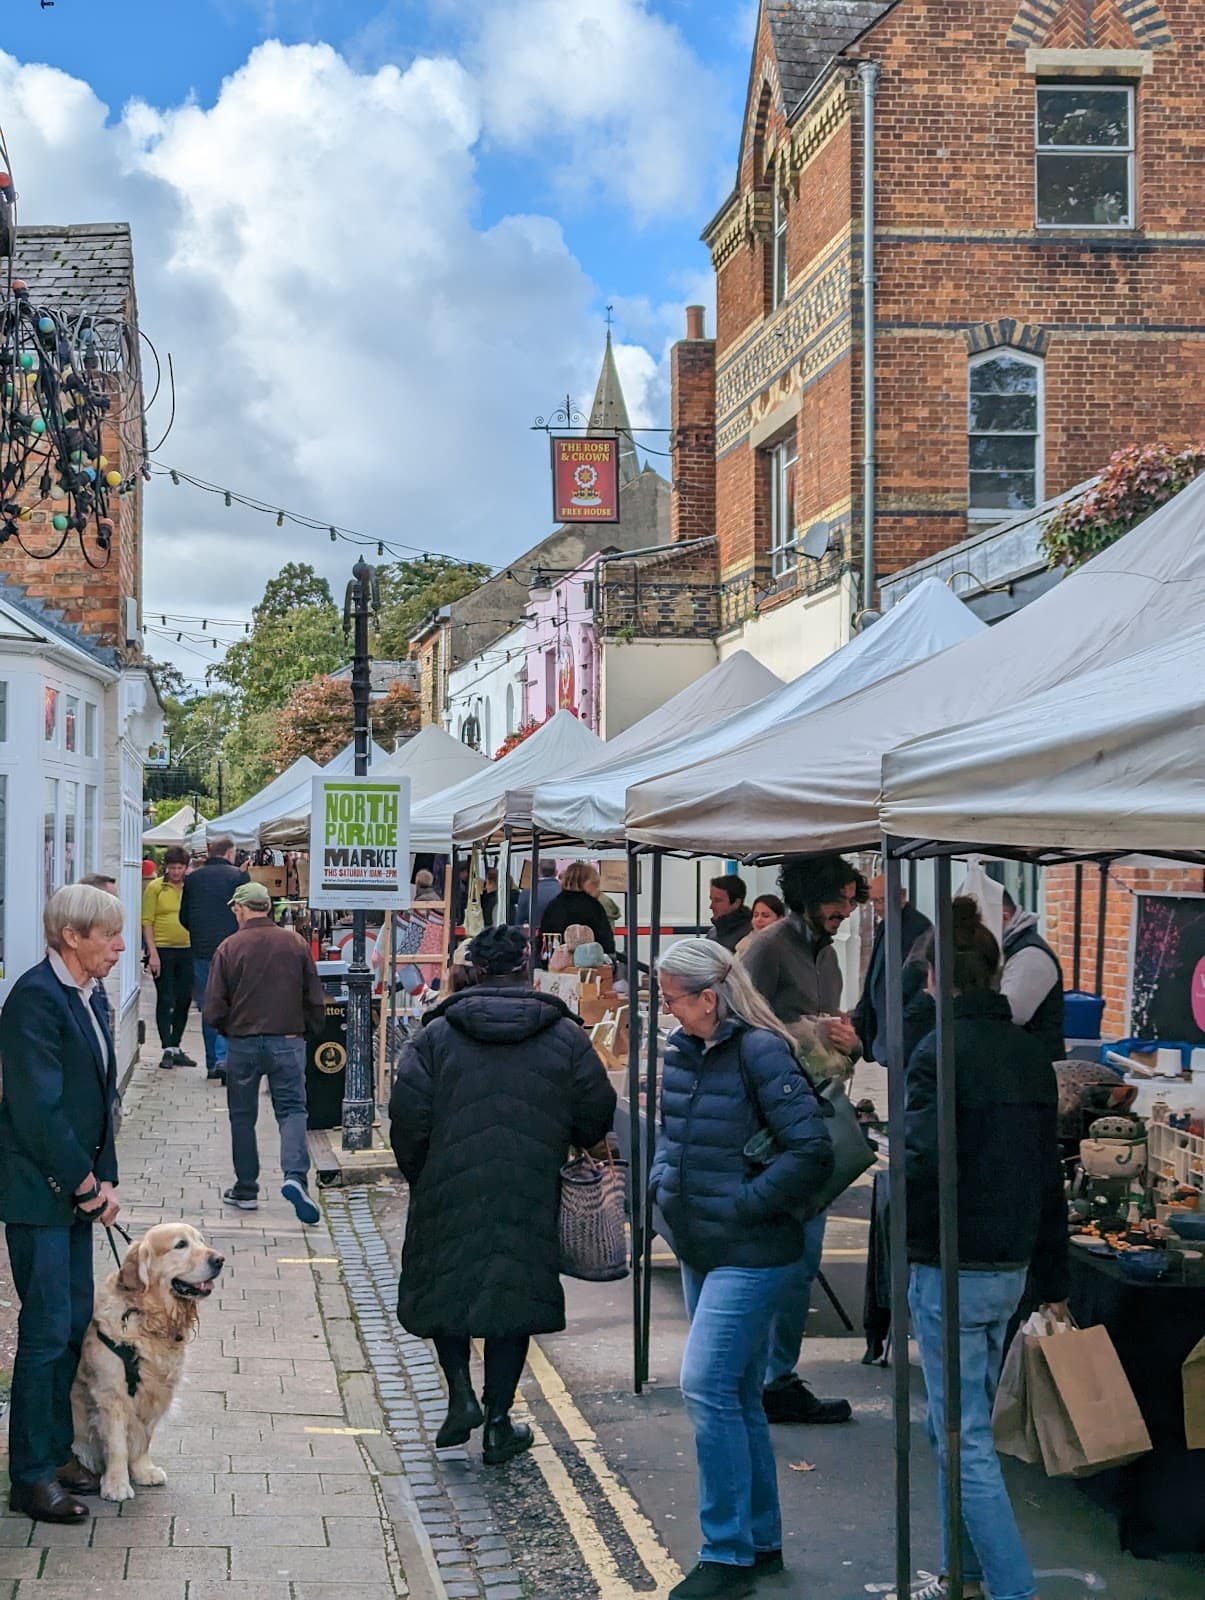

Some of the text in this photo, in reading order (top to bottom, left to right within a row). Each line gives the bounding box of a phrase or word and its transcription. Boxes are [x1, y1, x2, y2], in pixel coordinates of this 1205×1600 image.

[560, 443, 610, 452] THE ROSE
[561, 452, 610, 462] & CROWN
[561, 508, 611, 516] FREE HOUSE
[325, 793, 398, 823] NORTH
[325, 823, 397, 846] PARADE
[324, 848, 397, 867] MARKET
[324, 868, 337, 877] THIS
[339, 868, 367, 878] SATURDAY
[325, 1006, 345, 1016] tter
